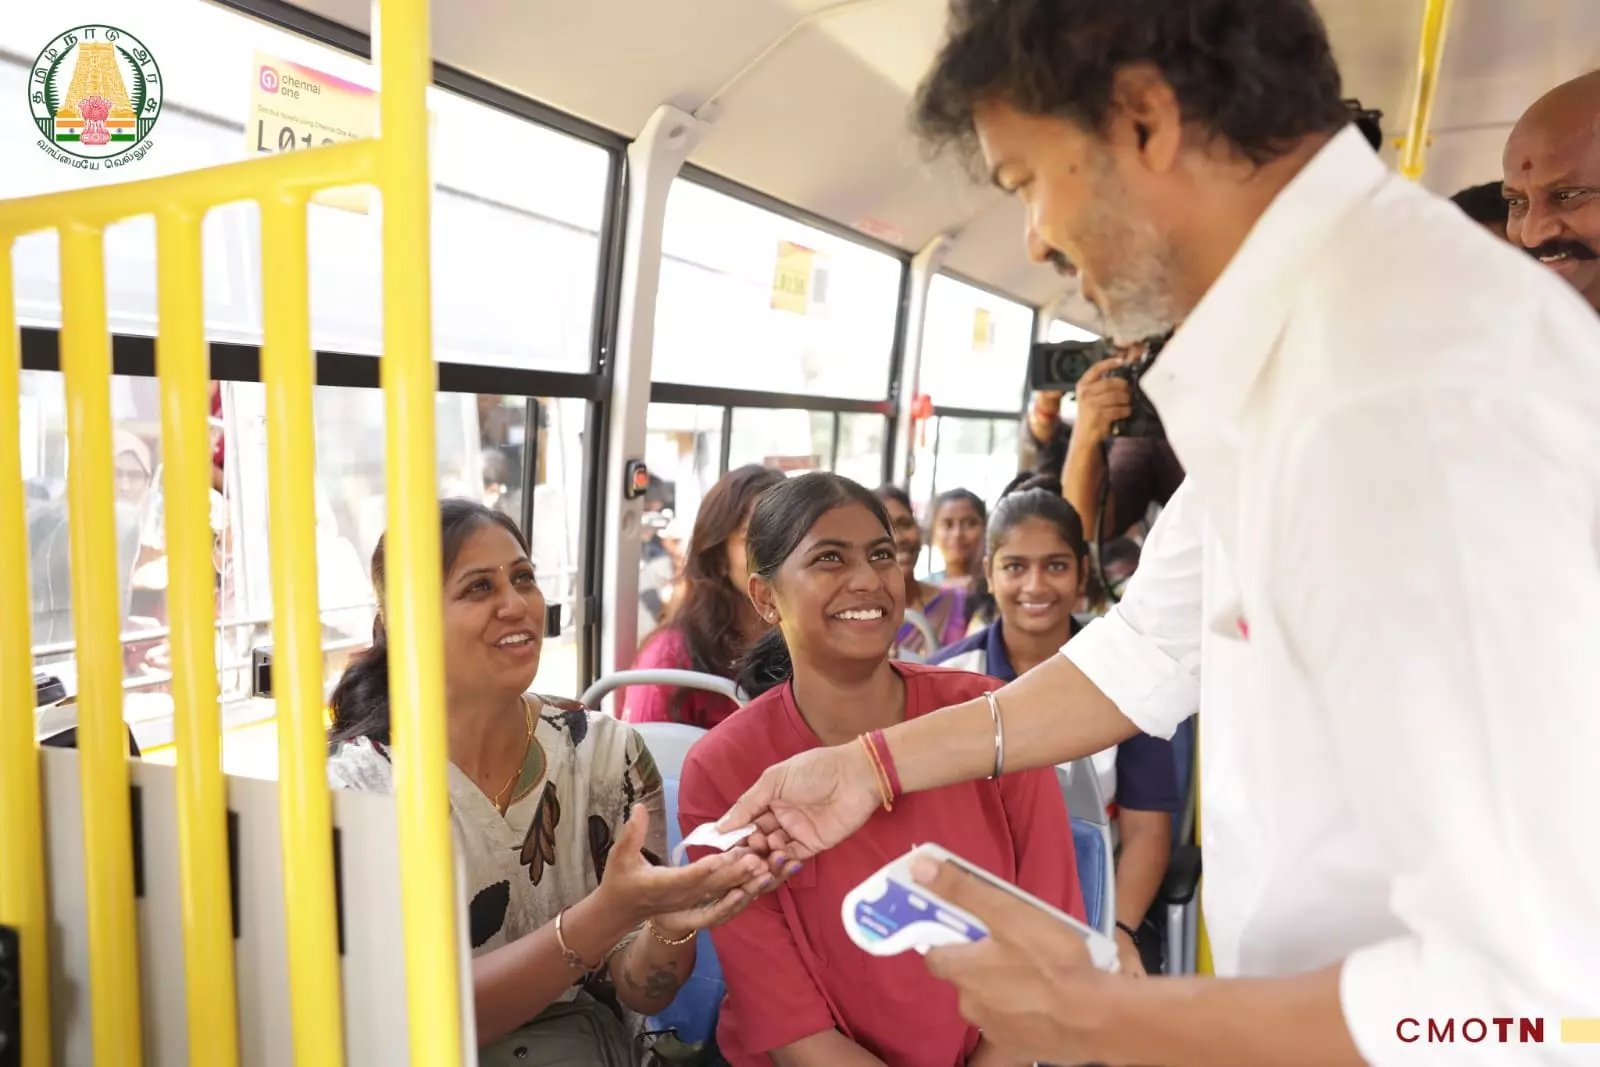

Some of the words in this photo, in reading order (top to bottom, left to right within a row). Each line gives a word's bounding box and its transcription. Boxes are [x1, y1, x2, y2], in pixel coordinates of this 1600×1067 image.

[281, 86, 300, 100] one
[282, 74, 321, 95] chennai
[257, 119, 335, 152] L01
